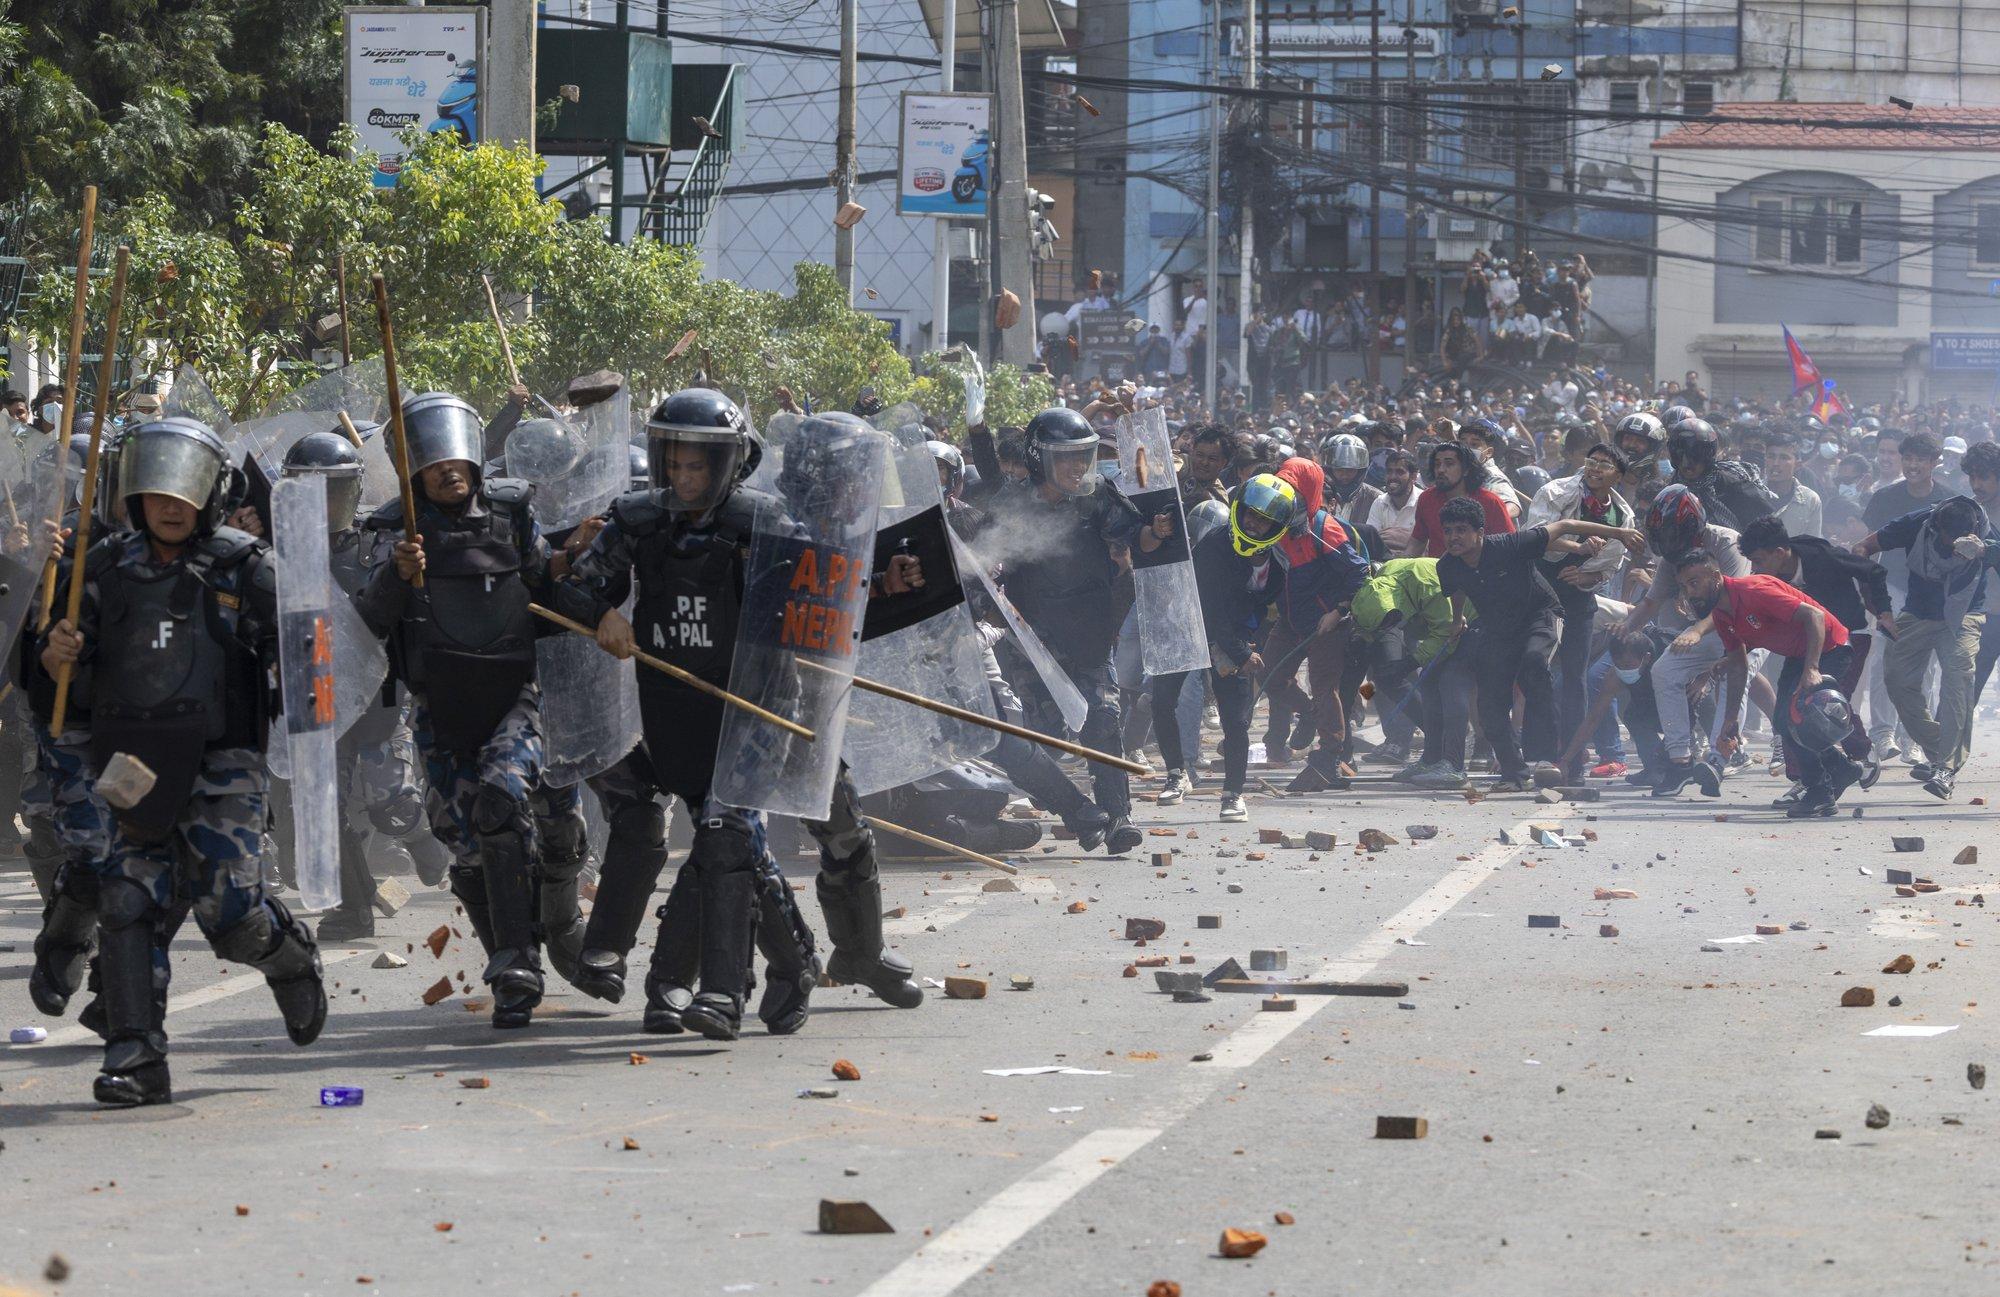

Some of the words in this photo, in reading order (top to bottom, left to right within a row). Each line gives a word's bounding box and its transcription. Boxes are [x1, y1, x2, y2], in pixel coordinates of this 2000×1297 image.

[1936, 338, 1944, 349] A
[1945, 338, 1959, 349] TO
[1959, 338, 1968, 349] Z
